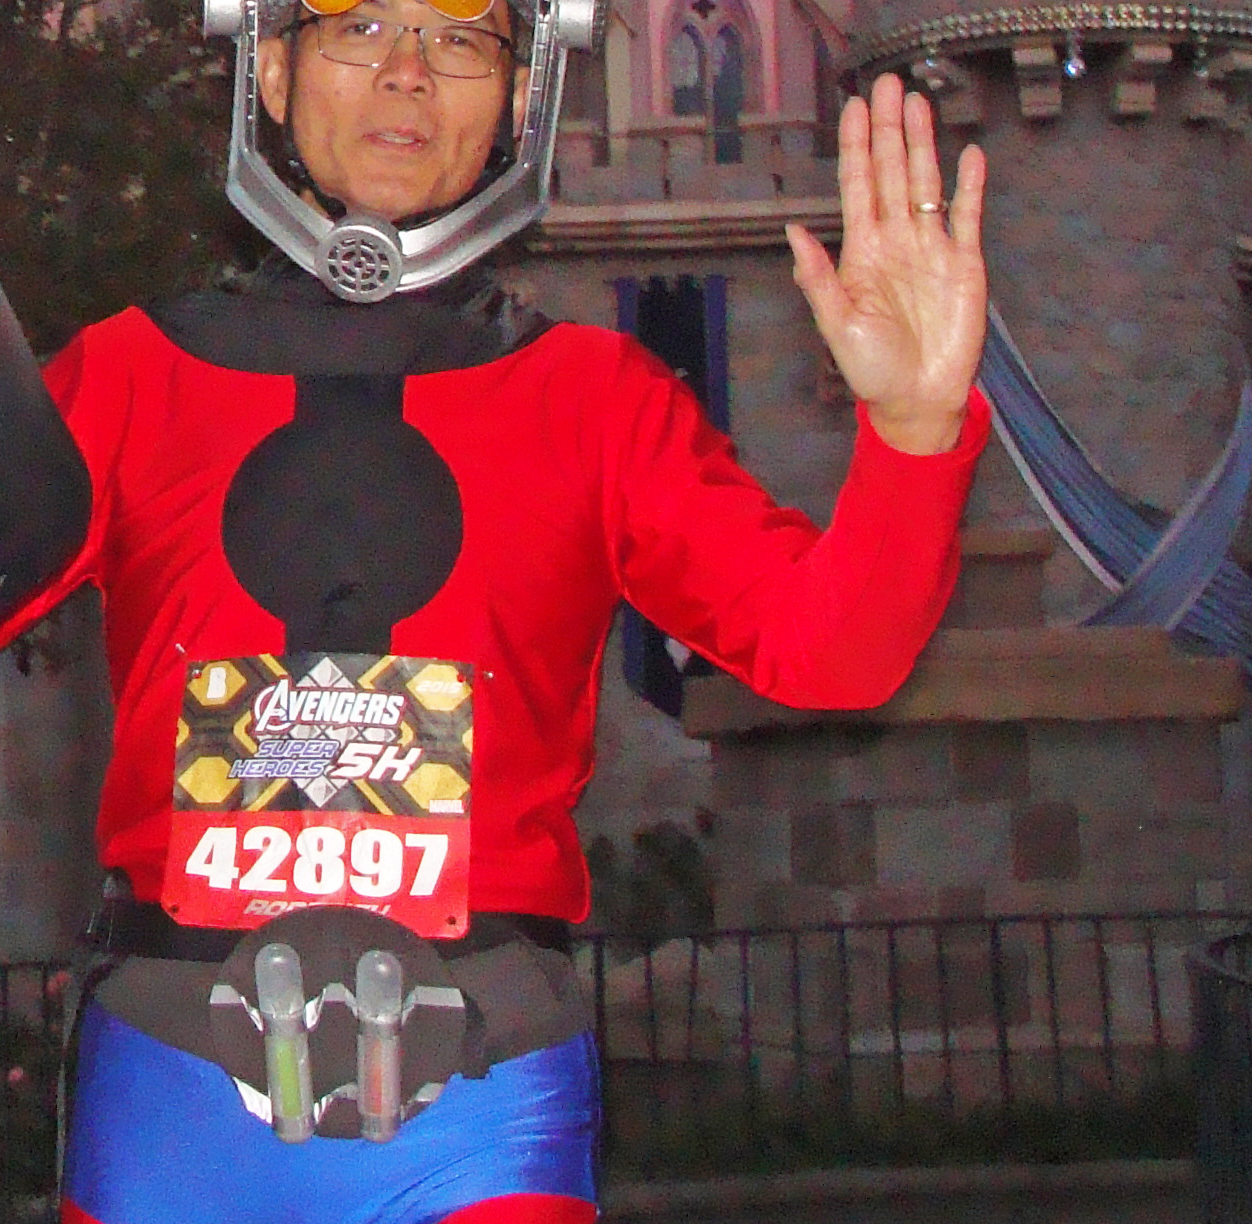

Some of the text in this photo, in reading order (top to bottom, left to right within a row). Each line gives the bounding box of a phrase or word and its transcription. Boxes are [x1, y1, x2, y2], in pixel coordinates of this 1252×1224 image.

[254, 678, 405, 732] AVENGERS
[257, 740, 338, 758] SUPER
[331, 743, 422, 781] 5K
[230, 760, 328, 778] HEROES
[185, 825, 449, 897] 42897
